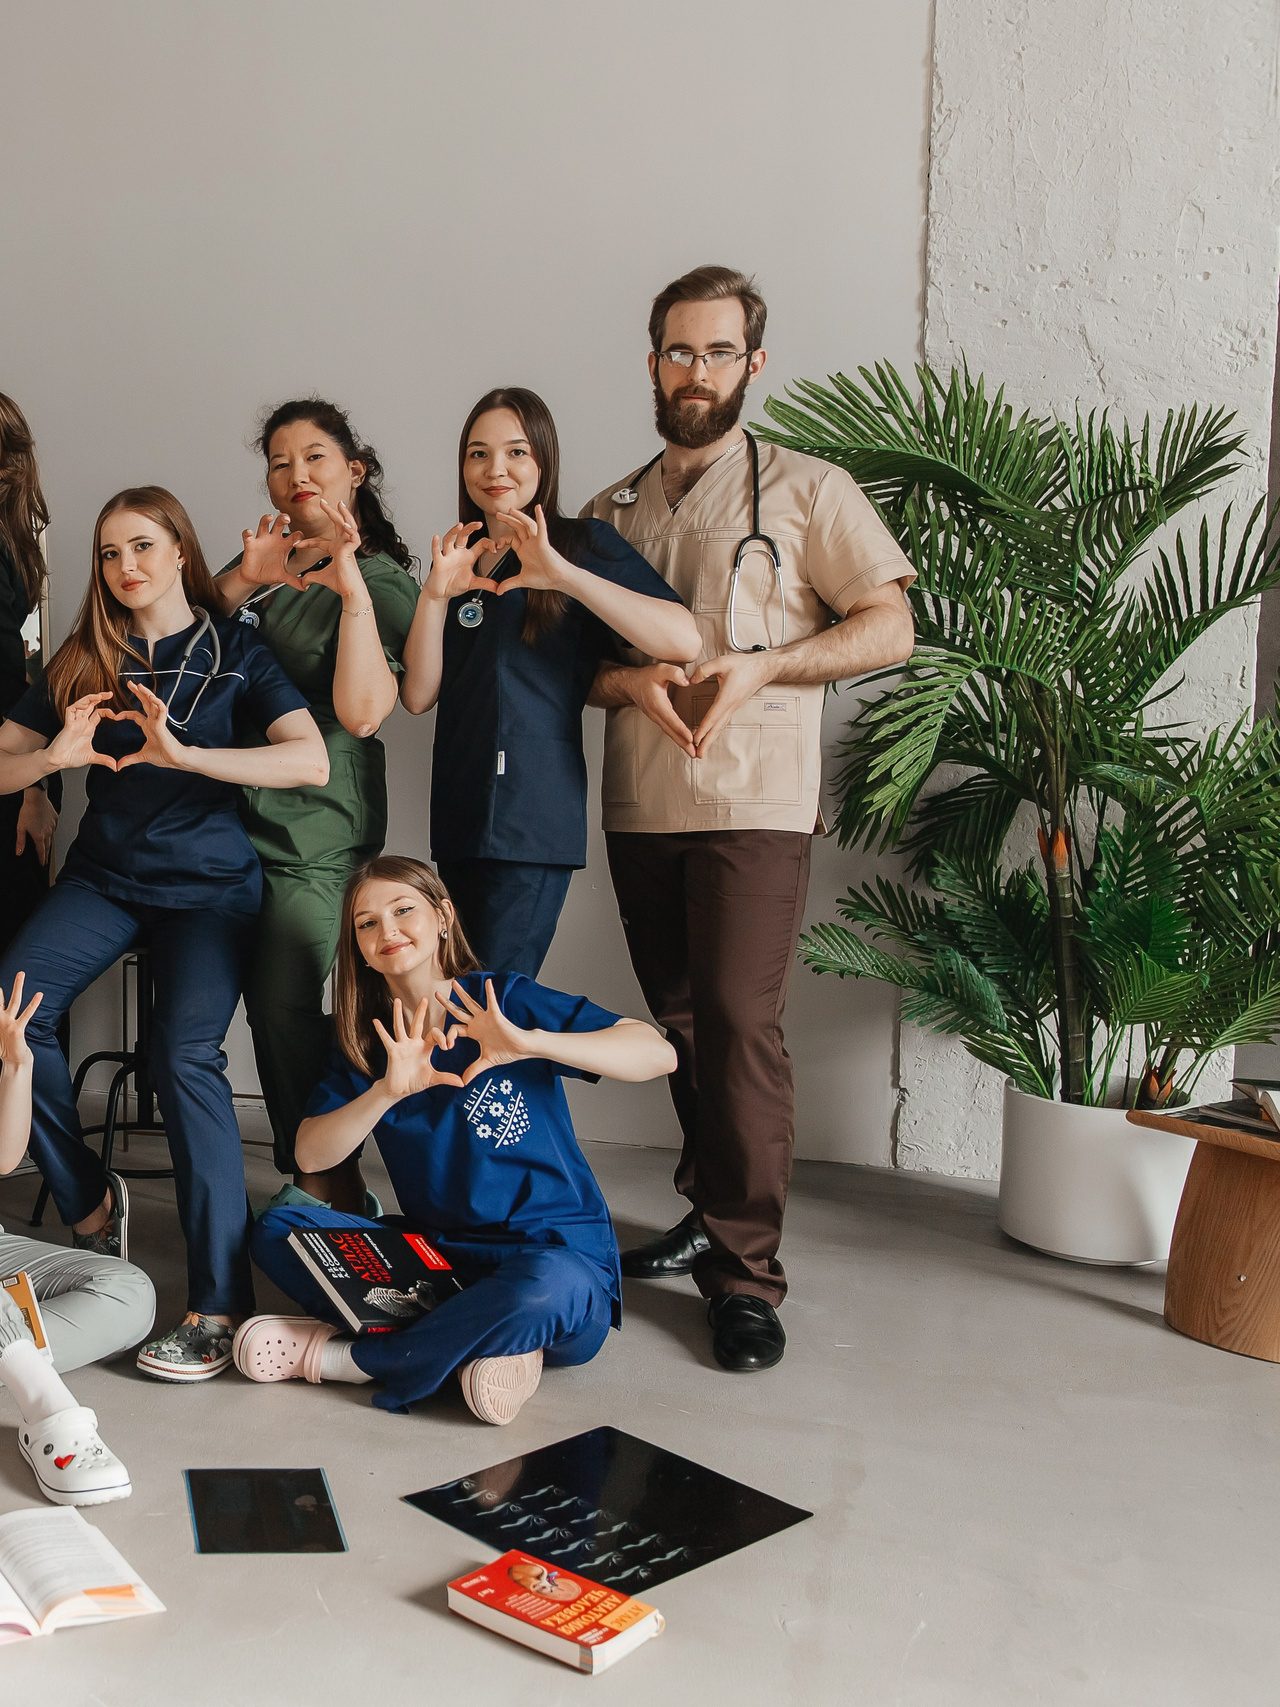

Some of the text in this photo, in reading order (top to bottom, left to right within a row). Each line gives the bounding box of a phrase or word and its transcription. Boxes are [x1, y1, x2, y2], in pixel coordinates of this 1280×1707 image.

[463, 1087, 481, 1111] ELIT
[470, 1084, 498, 1126] HEALTH
[492, 1095, 516, 1139] ENERGY
[328, 1233, 376, 1283] АТЛАС
[342, 1233, 385, 1283] АНАТОМИИ
[353, 1233, 391, 1283] ЧЕЛОВЕКА
[540, 1589, 608, 1628] ЧЕЛОВЕКА
[556, 1594, 622, 1636] АНАТОМИЯ
[609, 1604, 644, 1627] АТЛАС
